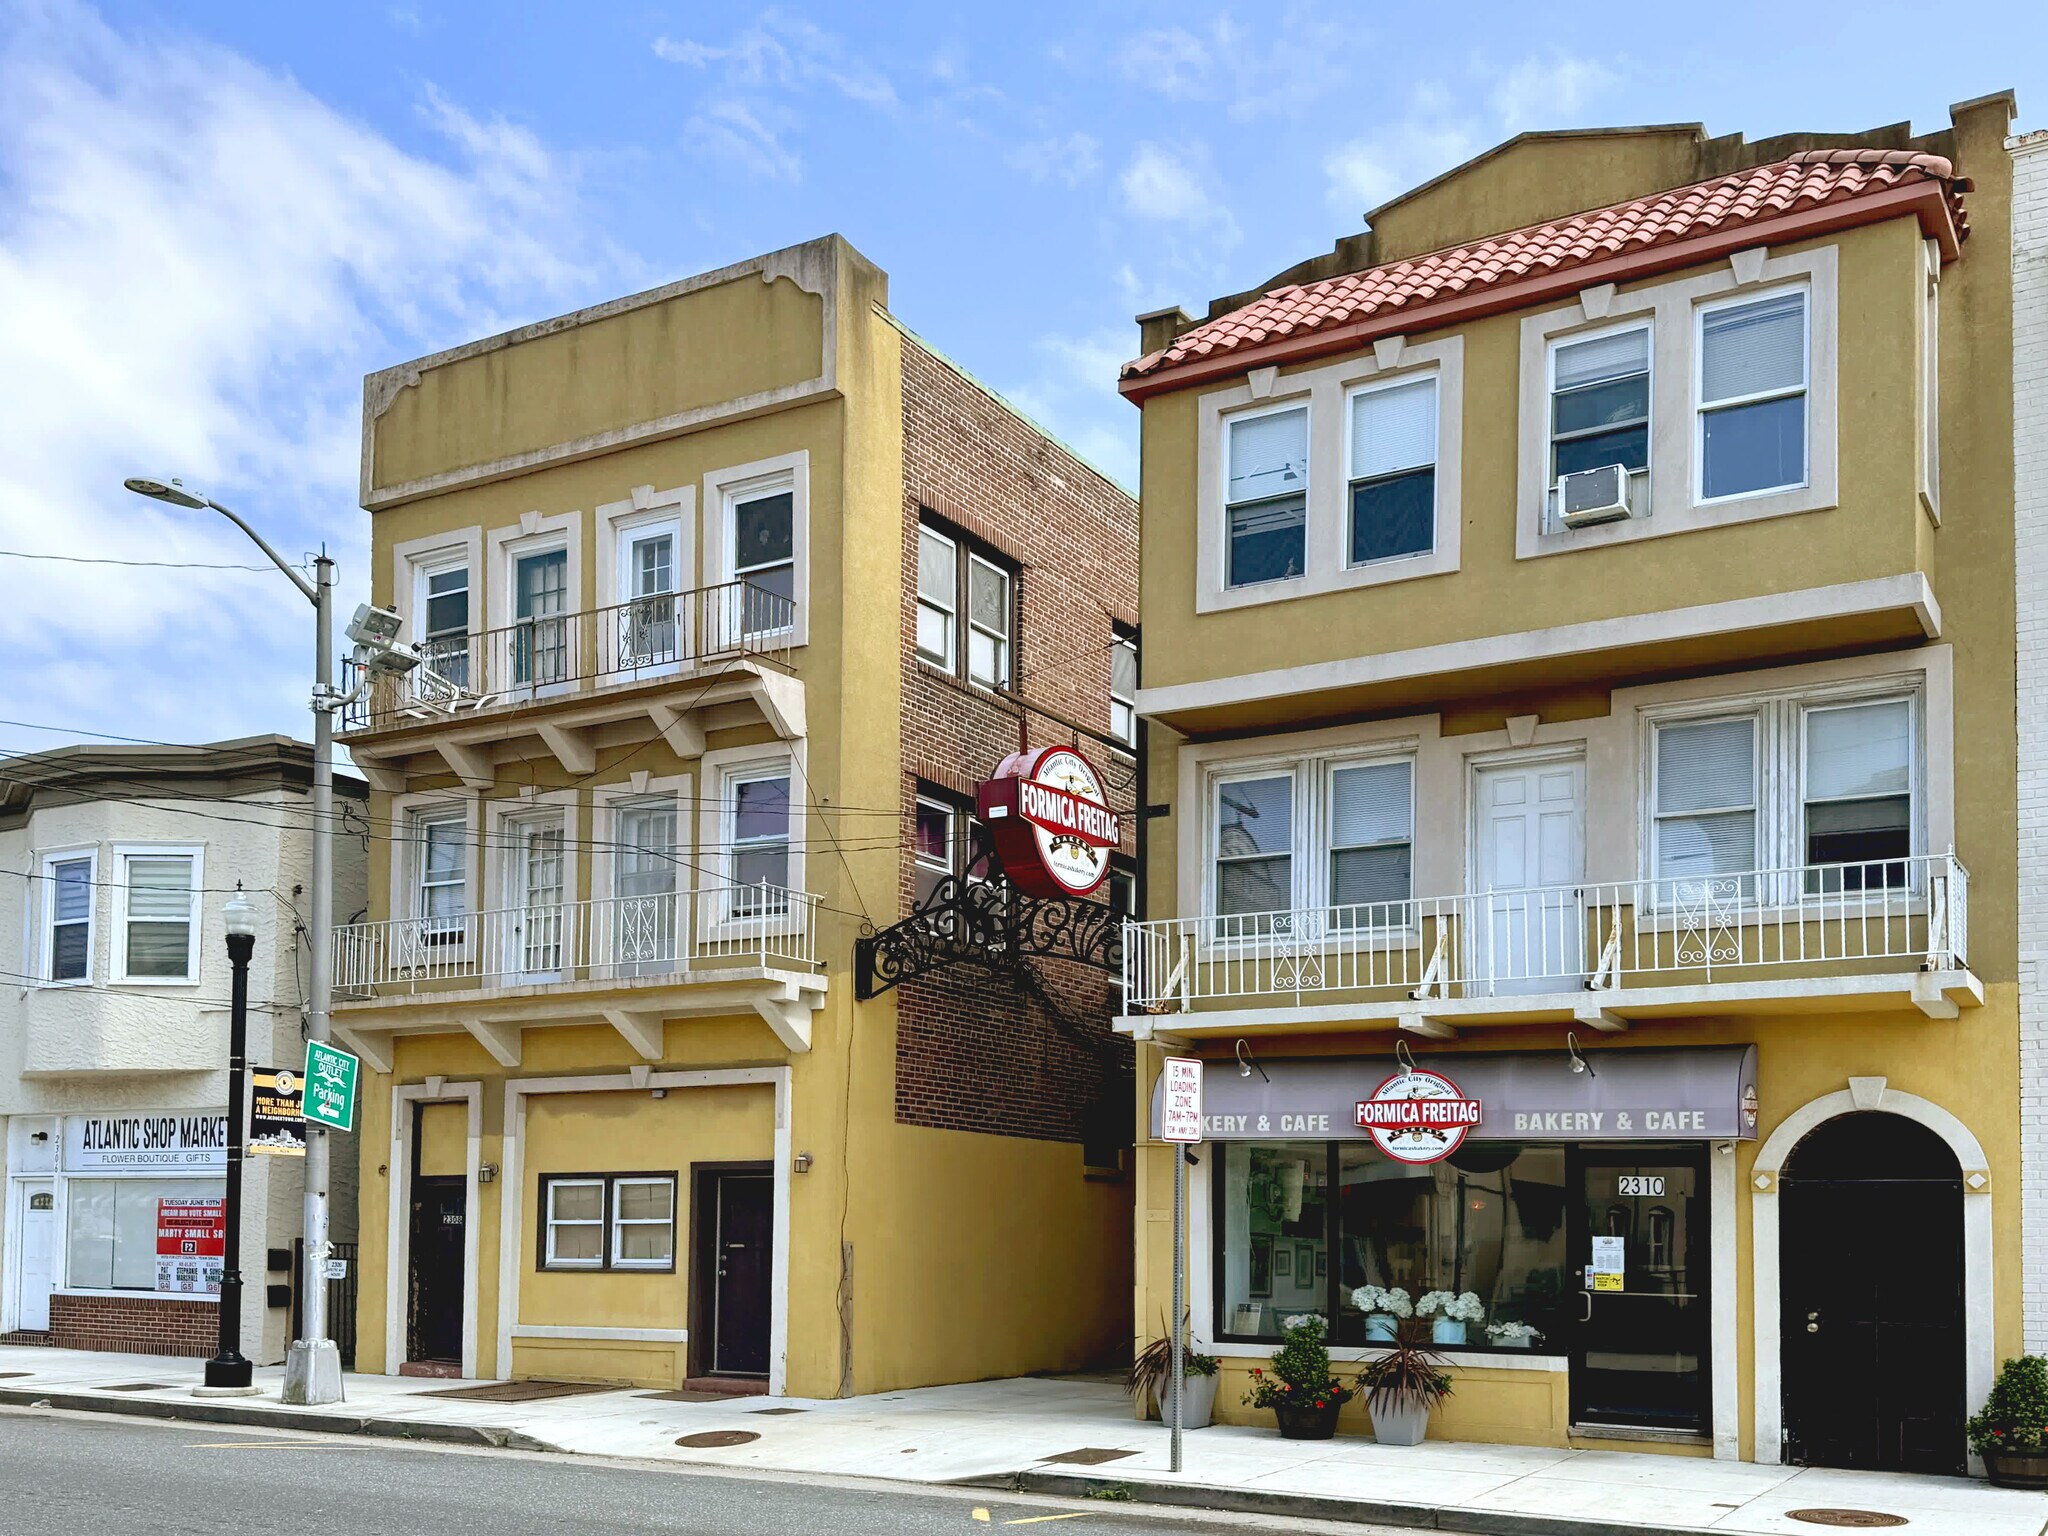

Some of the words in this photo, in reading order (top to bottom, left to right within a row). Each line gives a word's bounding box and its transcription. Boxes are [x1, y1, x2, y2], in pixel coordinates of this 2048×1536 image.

[1021, 782, 1077, 829] FORMICA
[1077, 801, 1119, 845] FREITAG
[1055, 835, 1094, 854] BAKERY
[314, 1049, 338, 1065] ATLANTIC
[338, 1058, 350, 1070] CITY
[318, 1062, 344, 1078] OUTLET
[1172, 1065, 1179, 1078] 15
[1181, 1066, 1196, 1079] MIN.
[1170, 1080, 1197, 1094] LOADING
[1382, 1079, 1405, 1096] Atlantic
[1407, 1075, 1422, 1083] City
[1424, 1076, 1452, 1095] Original
[256, 1096, 275, 1106] MORE
[276, 1098, 295, 1108] THAN
[312, 1082, 345, 1111] Parking
[1174, 1095, 1192, 1108] ZONE
[255, 1105, 261, 1114] A
[262, 1105, 302, 1117] NEIGHBORH
[1168, 1109, 1198, 1122] 7AM-7PM
[1356, 1102, 1420, 1123] FORMICA
[1421, 1101, 1478, 1123] FREITAG
[1201, 1115, 1248, 1132] KERY
[1256, 1114, 1271, 1132] &
[1280, 1114, 1330, 1132] CAFE
[1514, 1112, 1604, 1131] BAKERY
[1616, 1111, 1633, 1131] &
[1645, 1111, 1706, 1130] CAFE
[83, 1118, 140, 1150] ATLANTIC
[143, 1117, 177, 1149] SHOP
[1394, 1127, 1441, 1136] BAKERY
[101, 1154, 136, 1164] FLOWER
[137, 1153, 179, 1164] BOUTIQUE
[186, 1153, 211, 1163] GIFTS
[1620, 1177, 1664, 1195] 2310
[161, 1209, 179, 1217] DREAM
[179, 1209, 188, 1217] BIG
[189, 1209, 203, 1217] VOTE
[203, 1209, 222, 1218] SMALL
[159, 1228, 183, 1238] MARTY
[185, 1229, 210, 1239] SMALL
[213, 1229, 224, 1239] SR
[184, 1242, 194, 1252] F2
